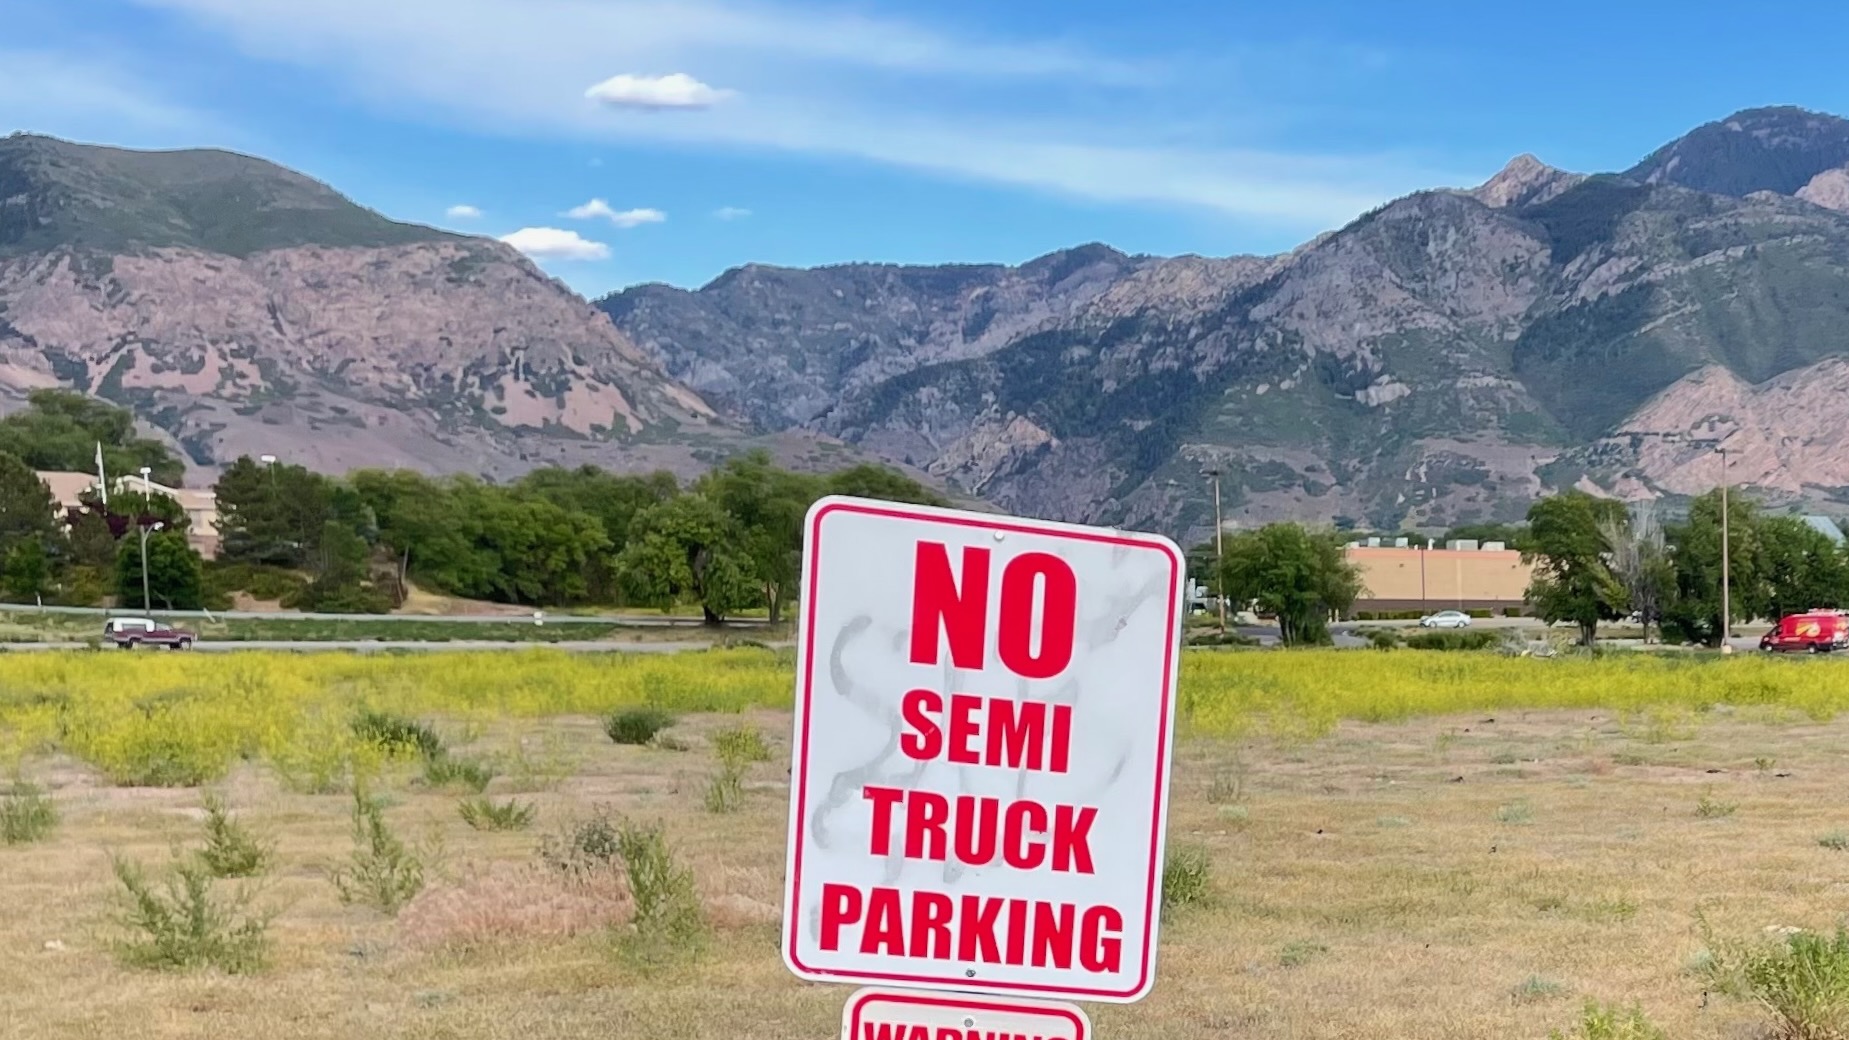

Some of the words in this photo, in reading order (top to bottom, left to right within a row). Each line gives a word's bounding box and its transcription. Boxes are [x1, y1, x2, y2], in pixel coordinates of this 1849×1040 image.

[909, 539, 1078, 680] NO
[899, 688, 1073, 774] SEMI
[863, 784, 1098, 875] TRUCK
[818, 882, 1124, 974] PARKING
